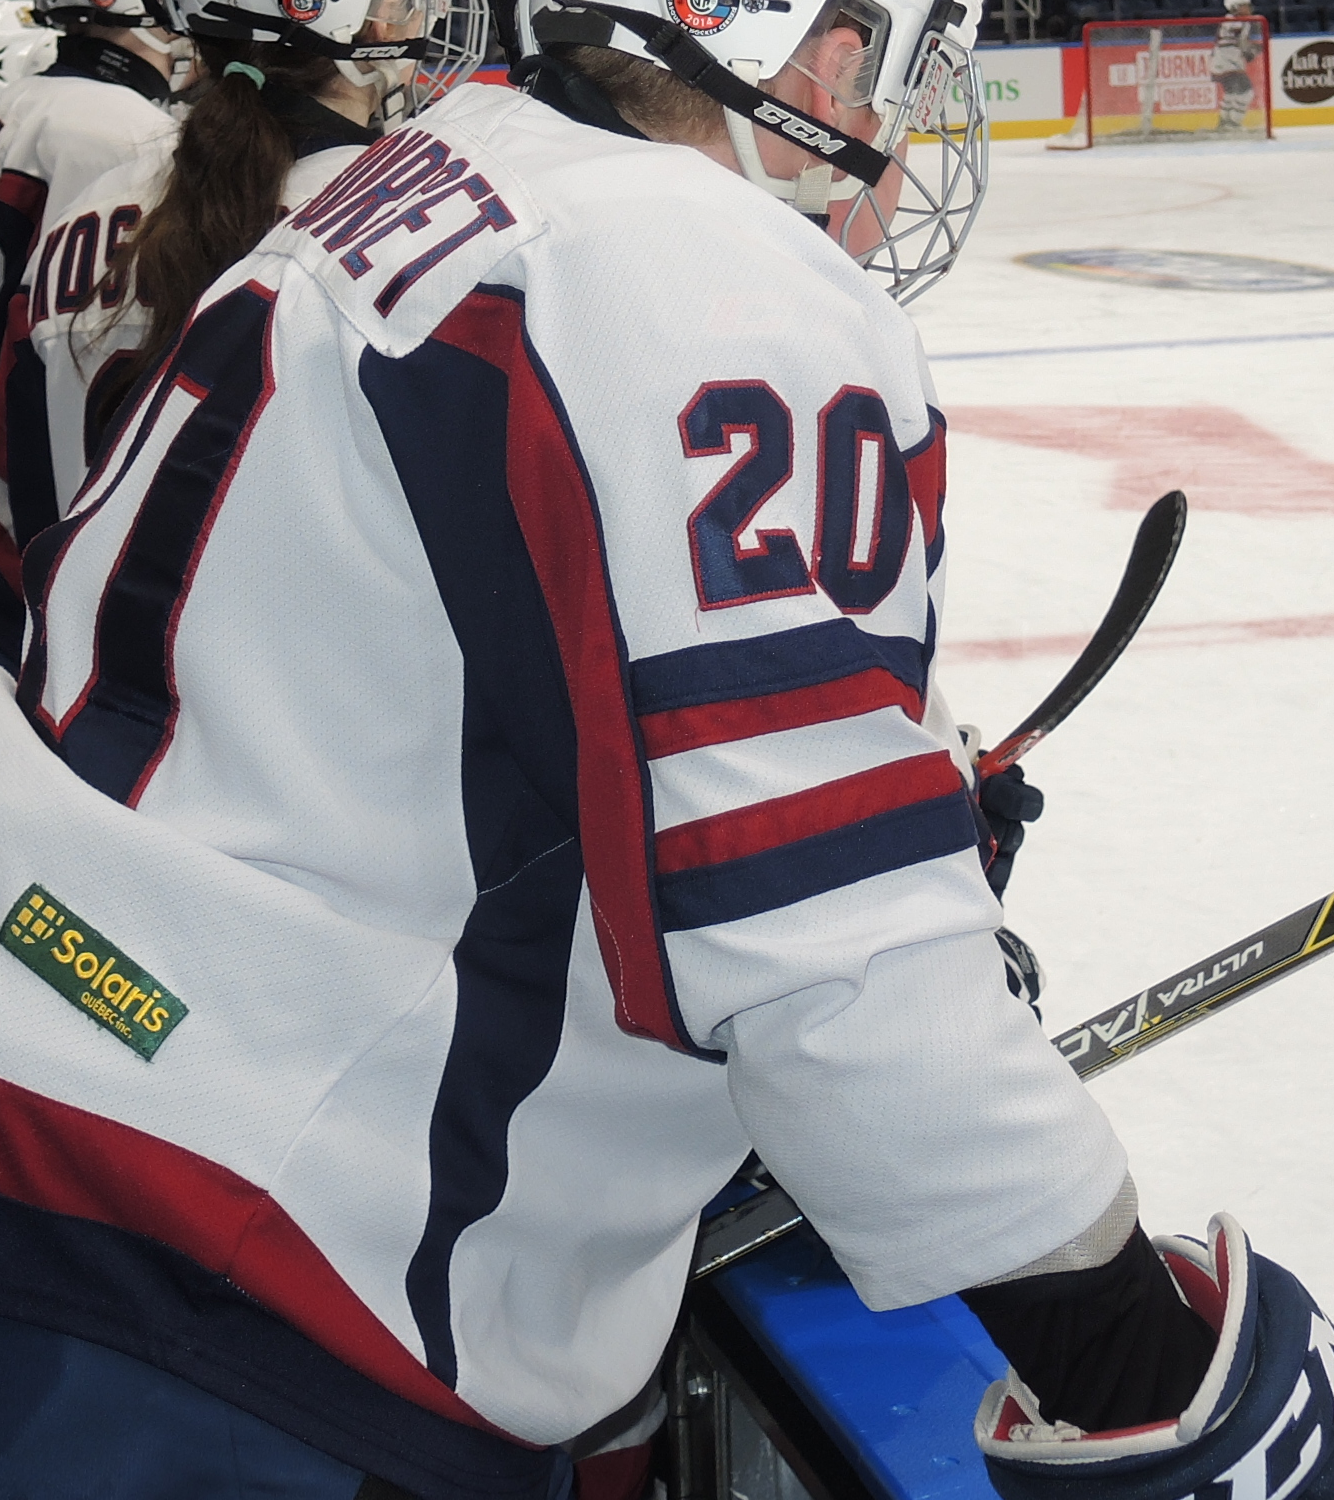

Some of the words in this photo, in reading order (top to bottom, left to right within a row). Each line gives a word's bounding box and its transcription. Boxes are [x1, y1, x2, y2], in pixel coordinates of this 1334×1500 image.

[685, 14, 714, 27] 2014
[351, 46, 408, 58] CCM
[753, 100, 846, 156] CCM
[677, 378, 915, 615] 20
[50, 927, 171, 1034] Solaris
[1157, 941, 1265, 1007] ULTRA
[79, 989, 118, 1026] QUÉBEC
